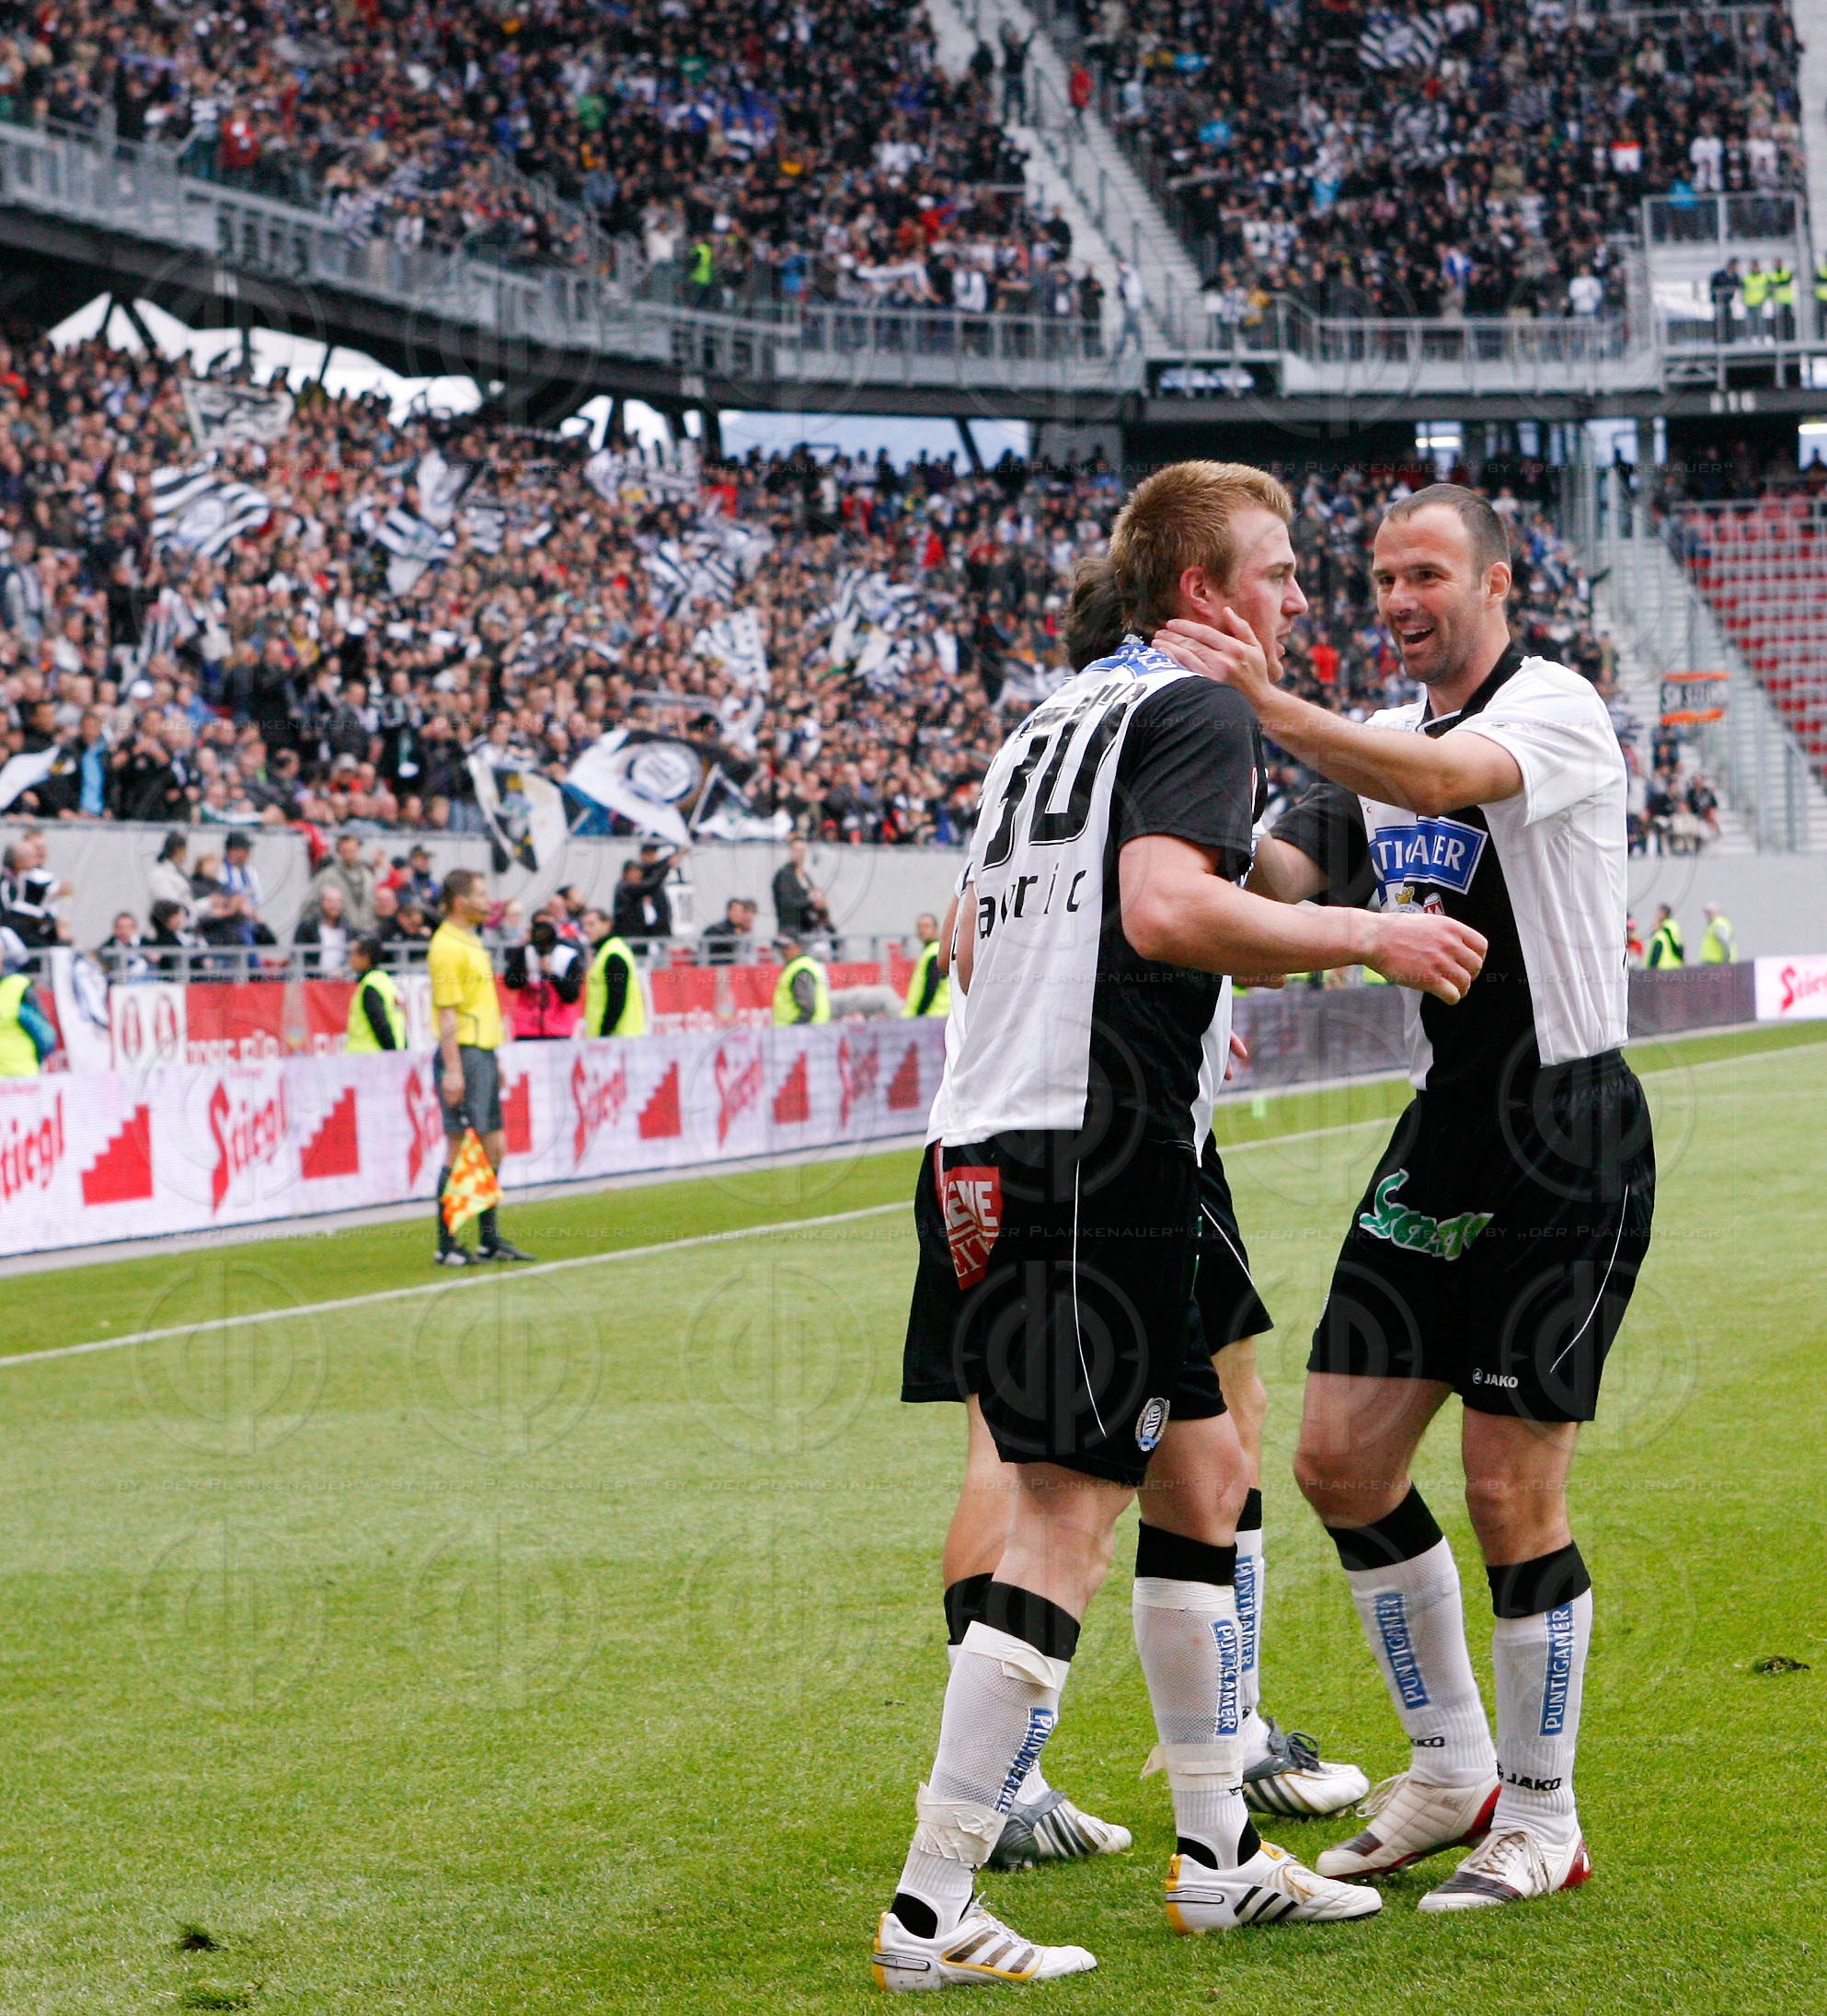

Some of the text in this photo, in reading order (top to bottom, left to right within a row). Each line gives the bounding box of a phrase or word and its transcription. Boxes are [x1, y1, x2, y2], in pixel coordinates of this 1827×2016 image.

[1484, 1374, 1518, 1388] JAKO
[1379, 1599, 1424, 1703] PUNTIGAMER
[1545, 1608, 1571, 1731] PUNTIGAMER
[1507, 1772, 1562, 1791] JAKO
